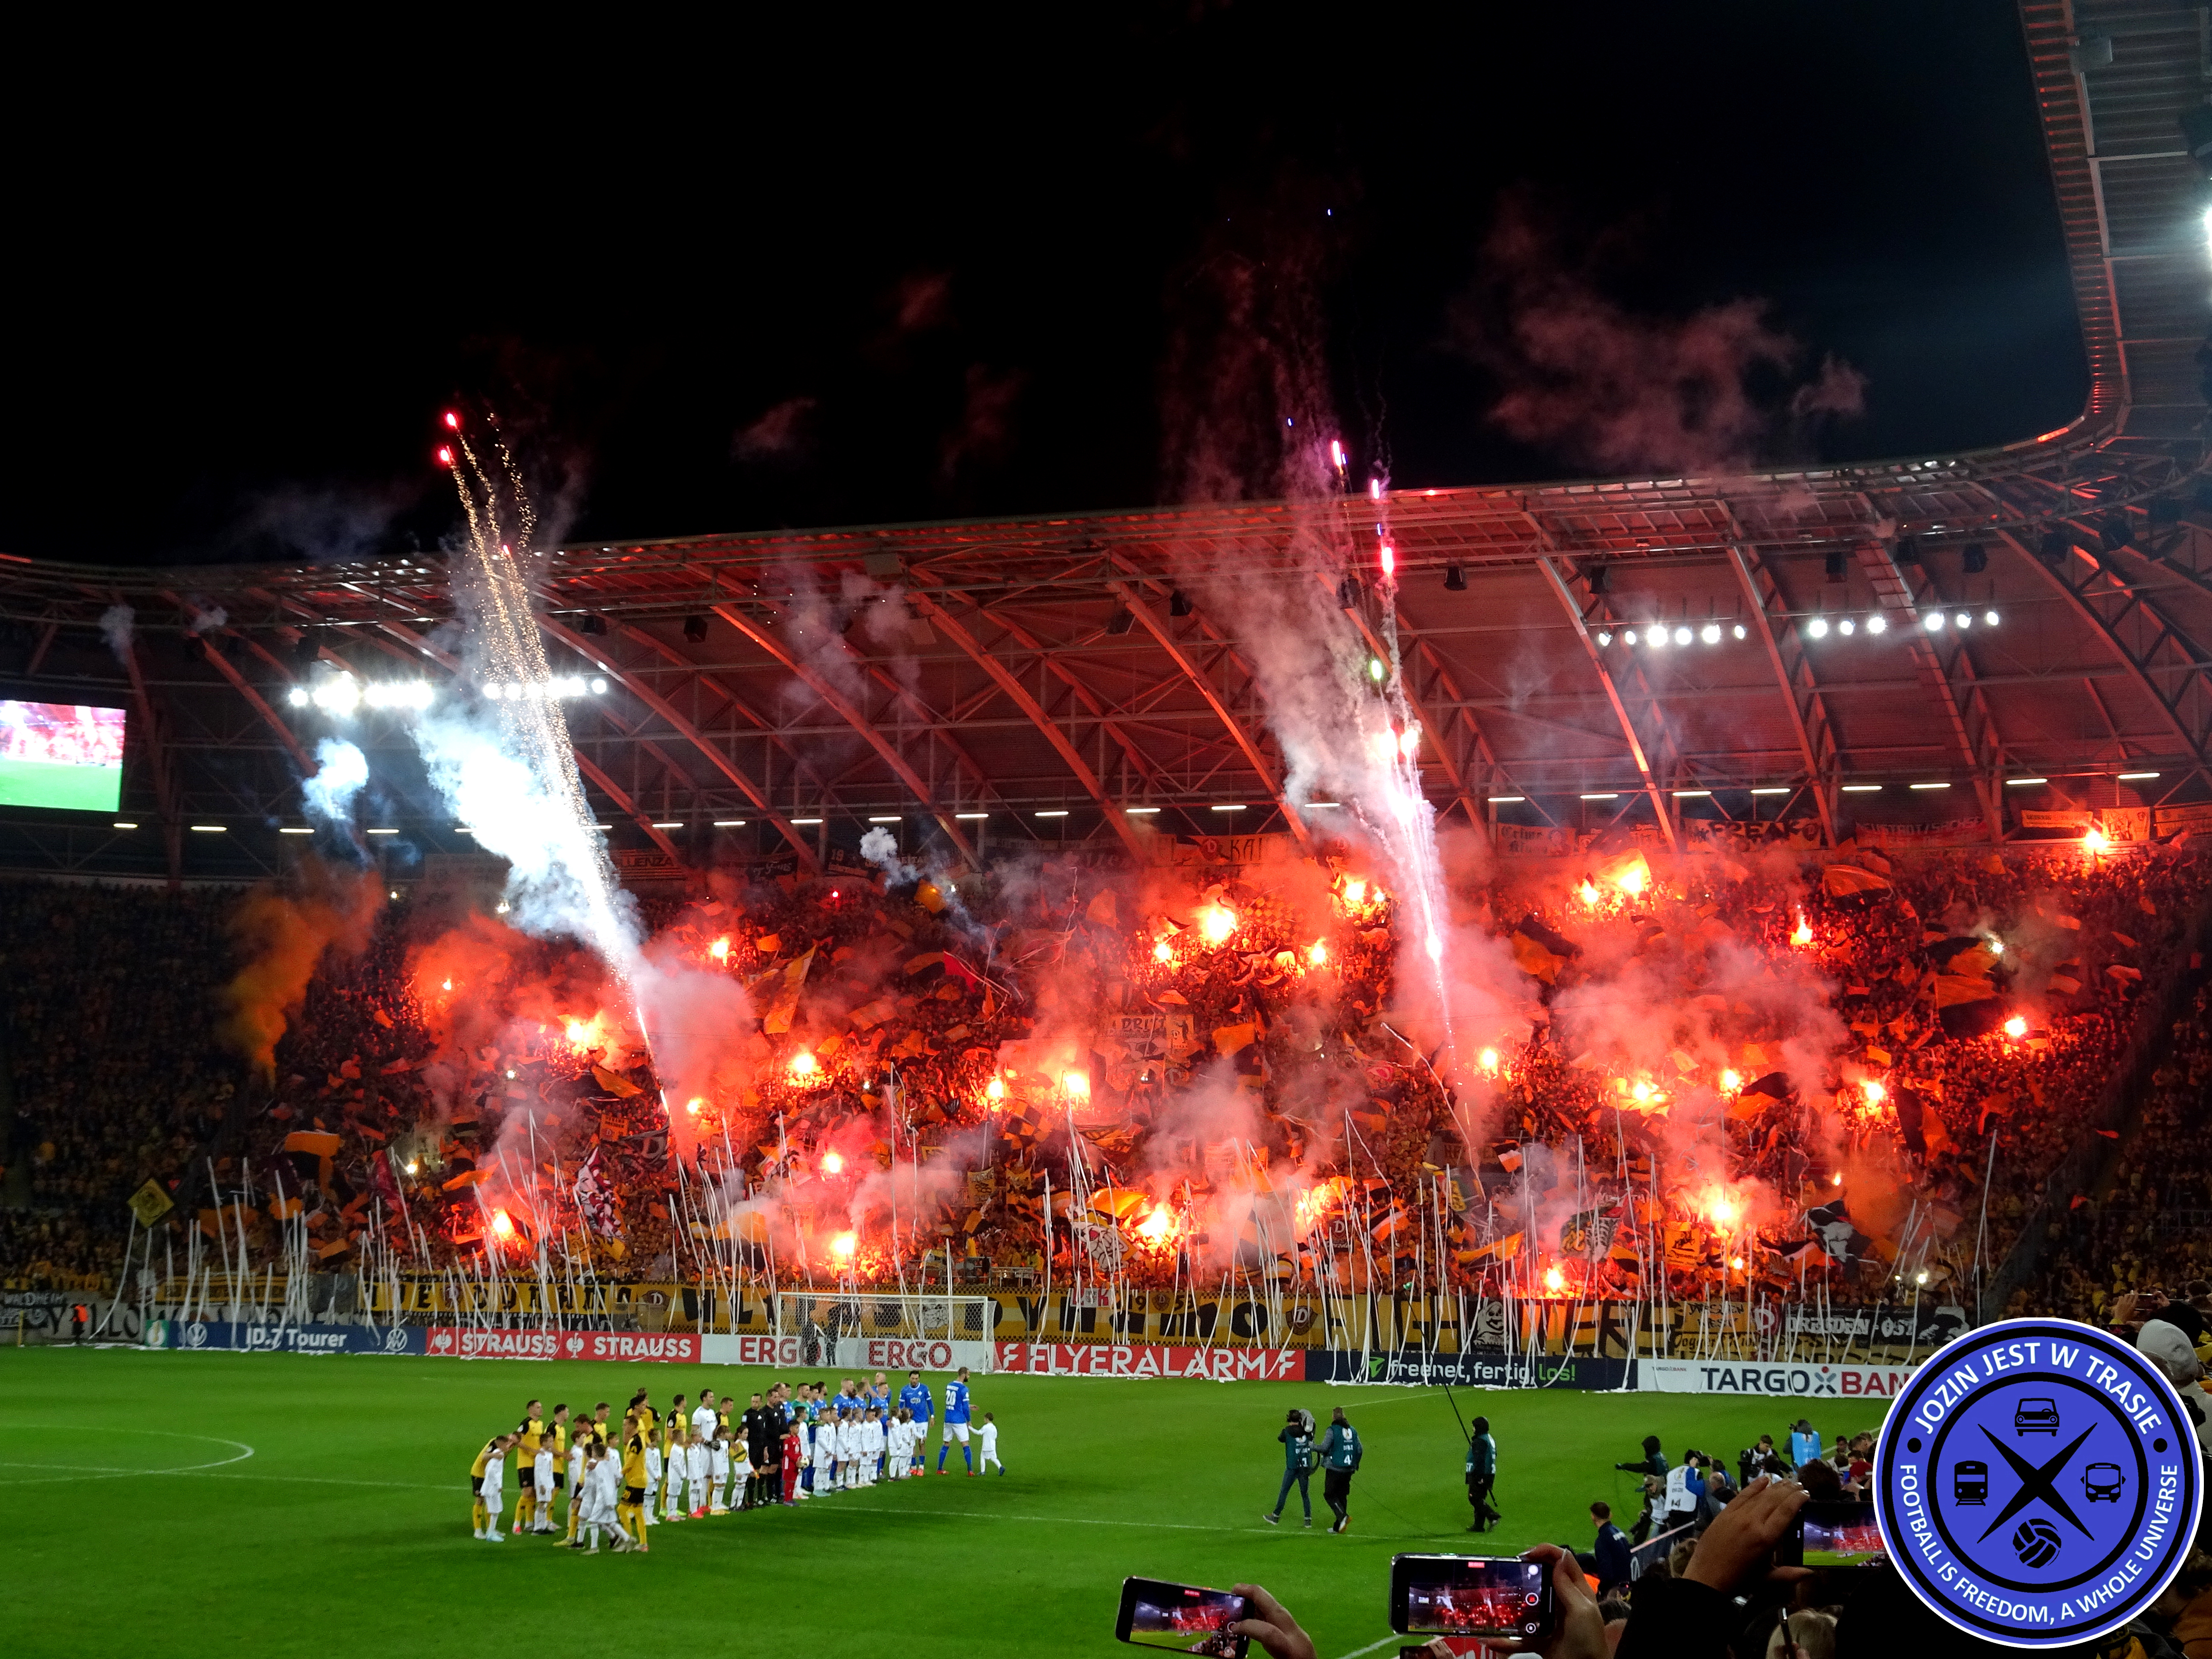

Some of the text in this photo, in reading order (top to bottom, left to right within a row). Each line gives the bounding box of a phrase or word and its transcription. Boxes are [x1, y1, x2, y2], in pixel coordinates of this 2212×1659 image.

[287, 1328, 347, 1348] Tourer
[462, 1333, 557, 1356] STRAUSS
[594, 1338, 692, 1358] STRAUSS
[868, 1340, 952, 1368] ERGO
[1029, 1344, 1266, 1380] FLYERALARM
[1538, 1364, 1576, 1382] los!
